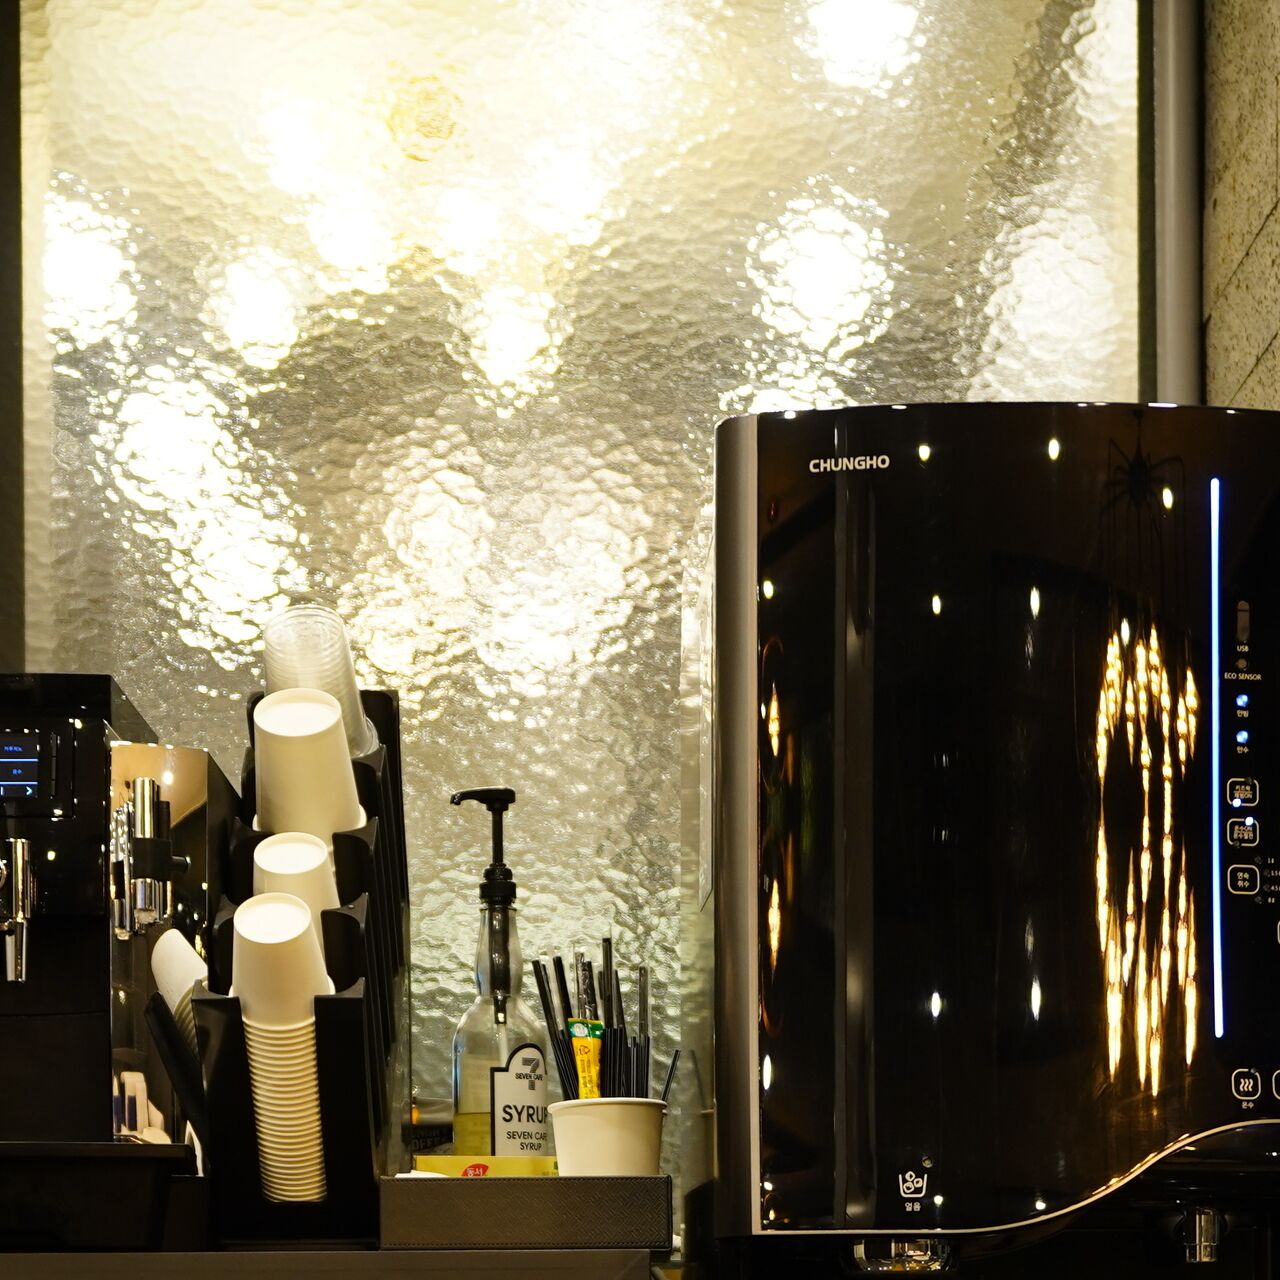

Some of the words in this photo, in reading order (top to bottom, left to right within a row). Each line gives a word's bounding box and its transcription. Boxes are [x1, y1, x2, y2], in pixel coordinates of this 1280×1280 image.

[809, 455, 890, 473] CHUNGHO
[1236, 645, 1249, 653] USB
[1224, 672, 1237, 680] ECO
[1238, 673, 1262, 681] SENSOR
[506, 1131, 533, 1140] SEVEN
[520, 1142, 542, 1151] SYRUP
[905, 1202, 921, 1211] 얼음
